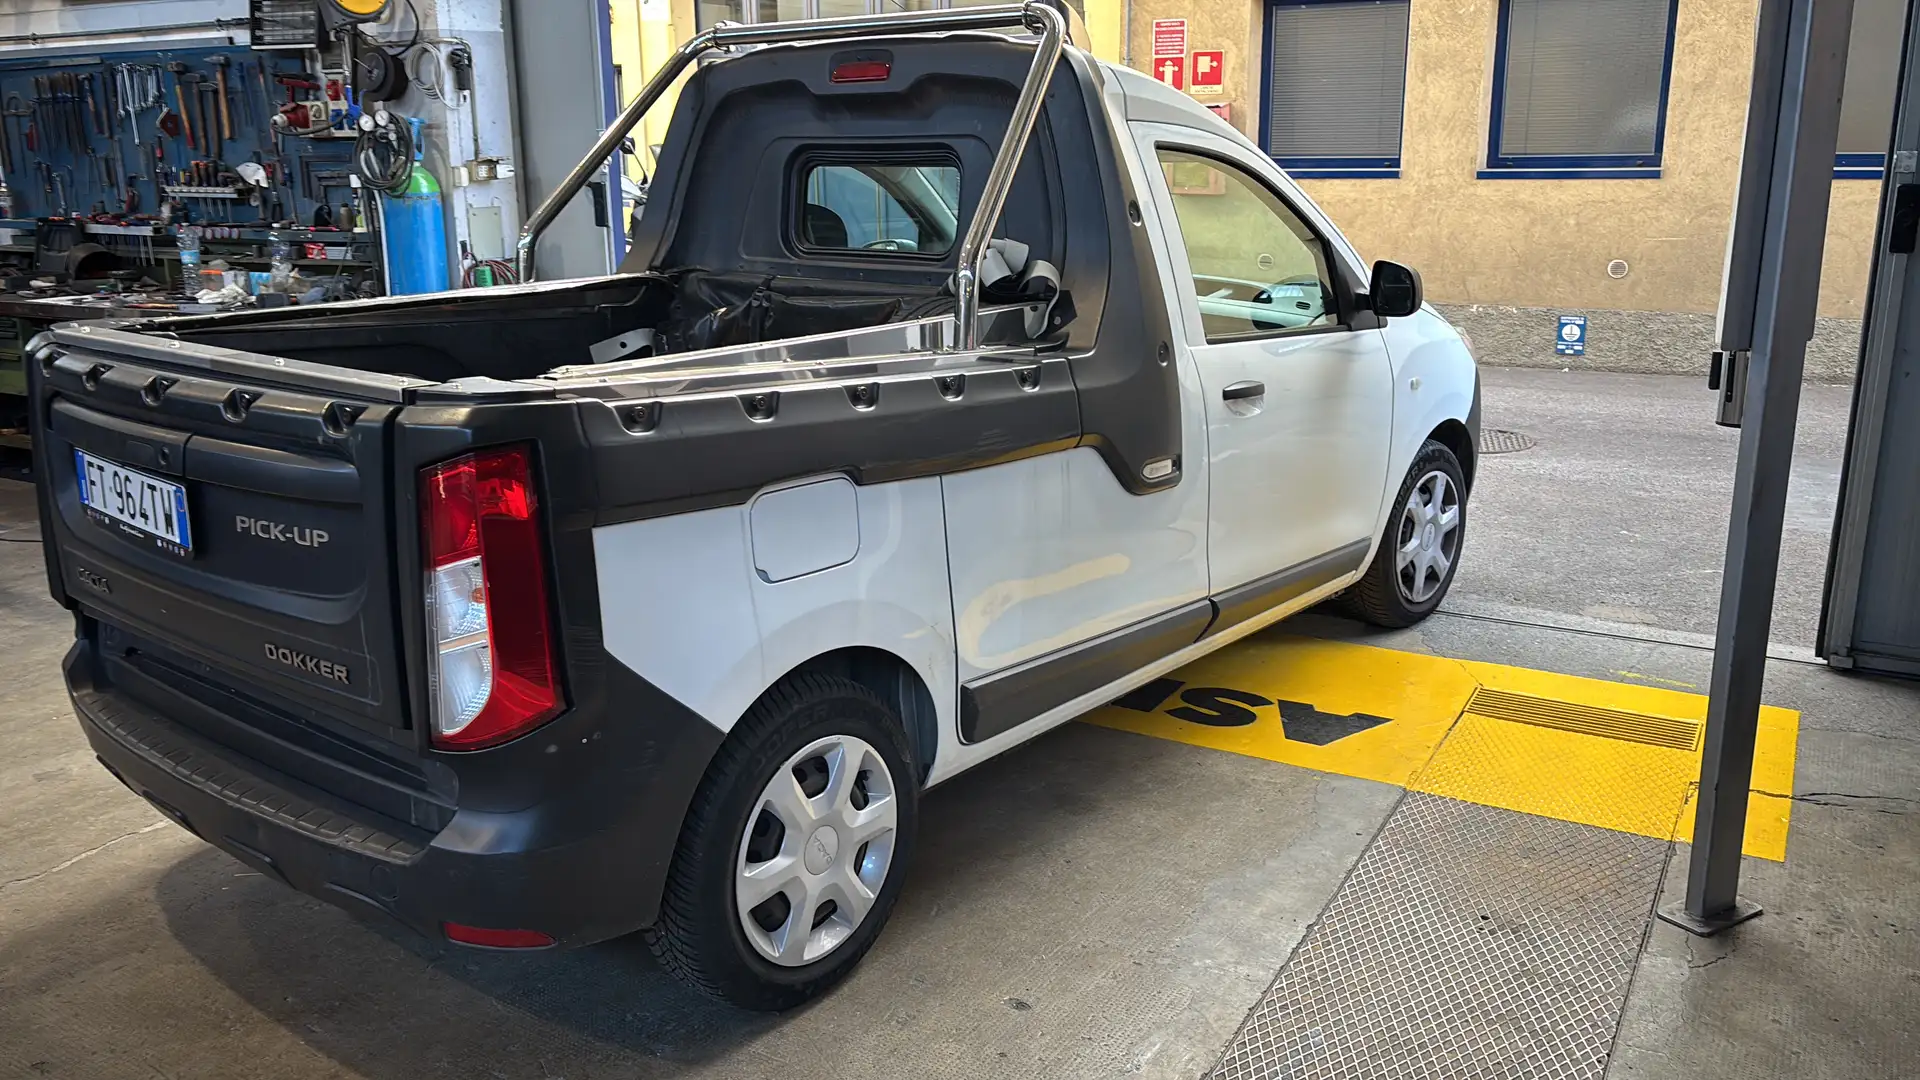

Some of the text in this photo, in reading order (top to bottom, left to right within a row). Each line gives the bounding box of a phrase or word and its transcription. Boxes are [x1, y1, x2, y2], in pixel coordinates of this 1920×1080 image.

[86, 460, 175, 537] FT 964TW
[235, 515, 330, 548] PICK-UP
[264, 643, 350, 685] DOKKER
